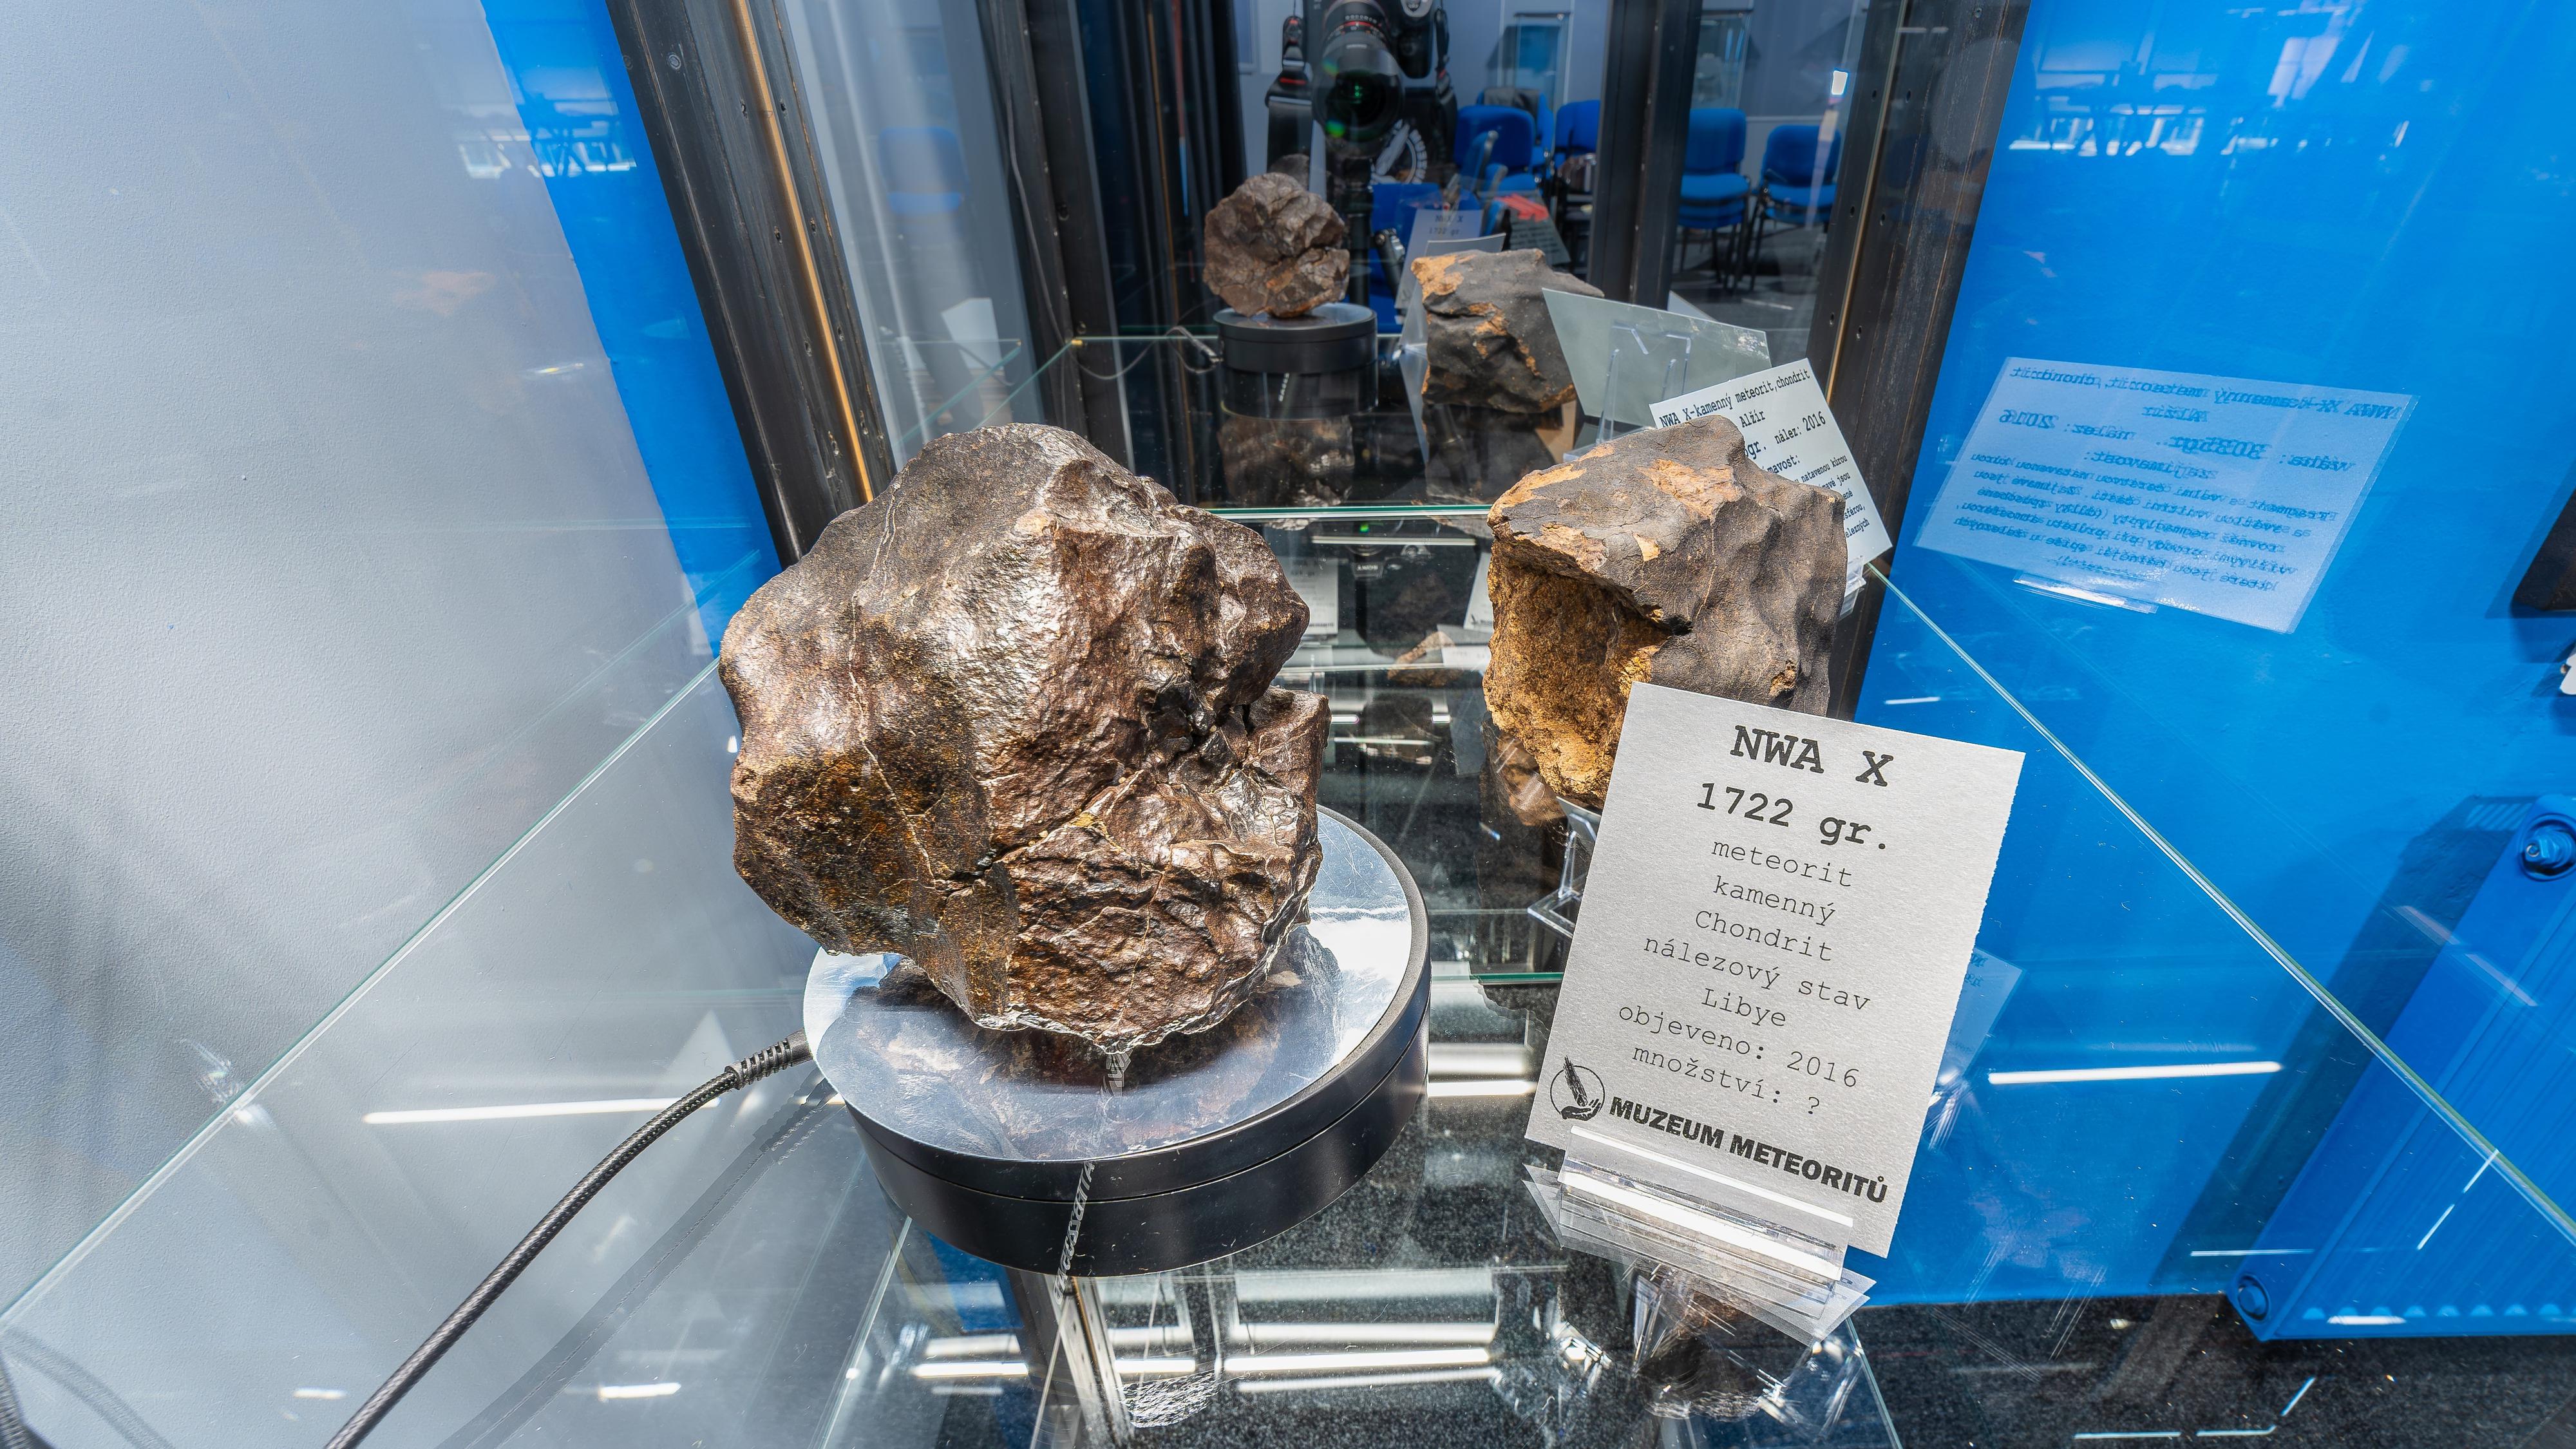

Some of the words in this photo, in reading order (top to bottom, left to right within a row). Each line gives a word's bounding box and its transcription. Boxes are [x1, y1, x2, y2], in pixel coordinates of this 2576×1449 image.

[1660, 412, 1681, 428] NWA
[1683, 393, 1733, 421] X-kamenný
[1739, 410, 1766, 428] Alžír
[1774, 426, 1802, 444] nález:
[1803, 411, 1826, 431] 2016
[1801, 463, 1831, 483] natavenou
[1830, 455, 1848, 468] kůrou
[1837, 471, 1851, 486] jsou
[1844, 518, 1870, 538] elezných
[1730, 724, 1824, 774] NWA
[1855, 750, 1895, 787] X
[1697, 782, 1794, 828] 1722
[1819, 813, 1887, 850] gr.
[1711, 837, 1854, 888] meteorit
[1714, 875, 1837, 926] kamenný
[1695, 909, 1834, 962] Chondrit
[1643, 936, 1781, 990] nálezový
[1797, 978, 1872, 1011] stav
[1701, 987, 1787, 1028] Libye
[1618, 1004, 1765, 1059] objeveno:
[1786, 1050, 1860, 1088] 2016
[1631, 1045, 1780, 1104] množství:
[1807, 1096, 1821, 1115] ?
[1609, 1096, 1725, 1150] MUZEUM
[1730, 1134, 1888, 1204] METEORITŮ
